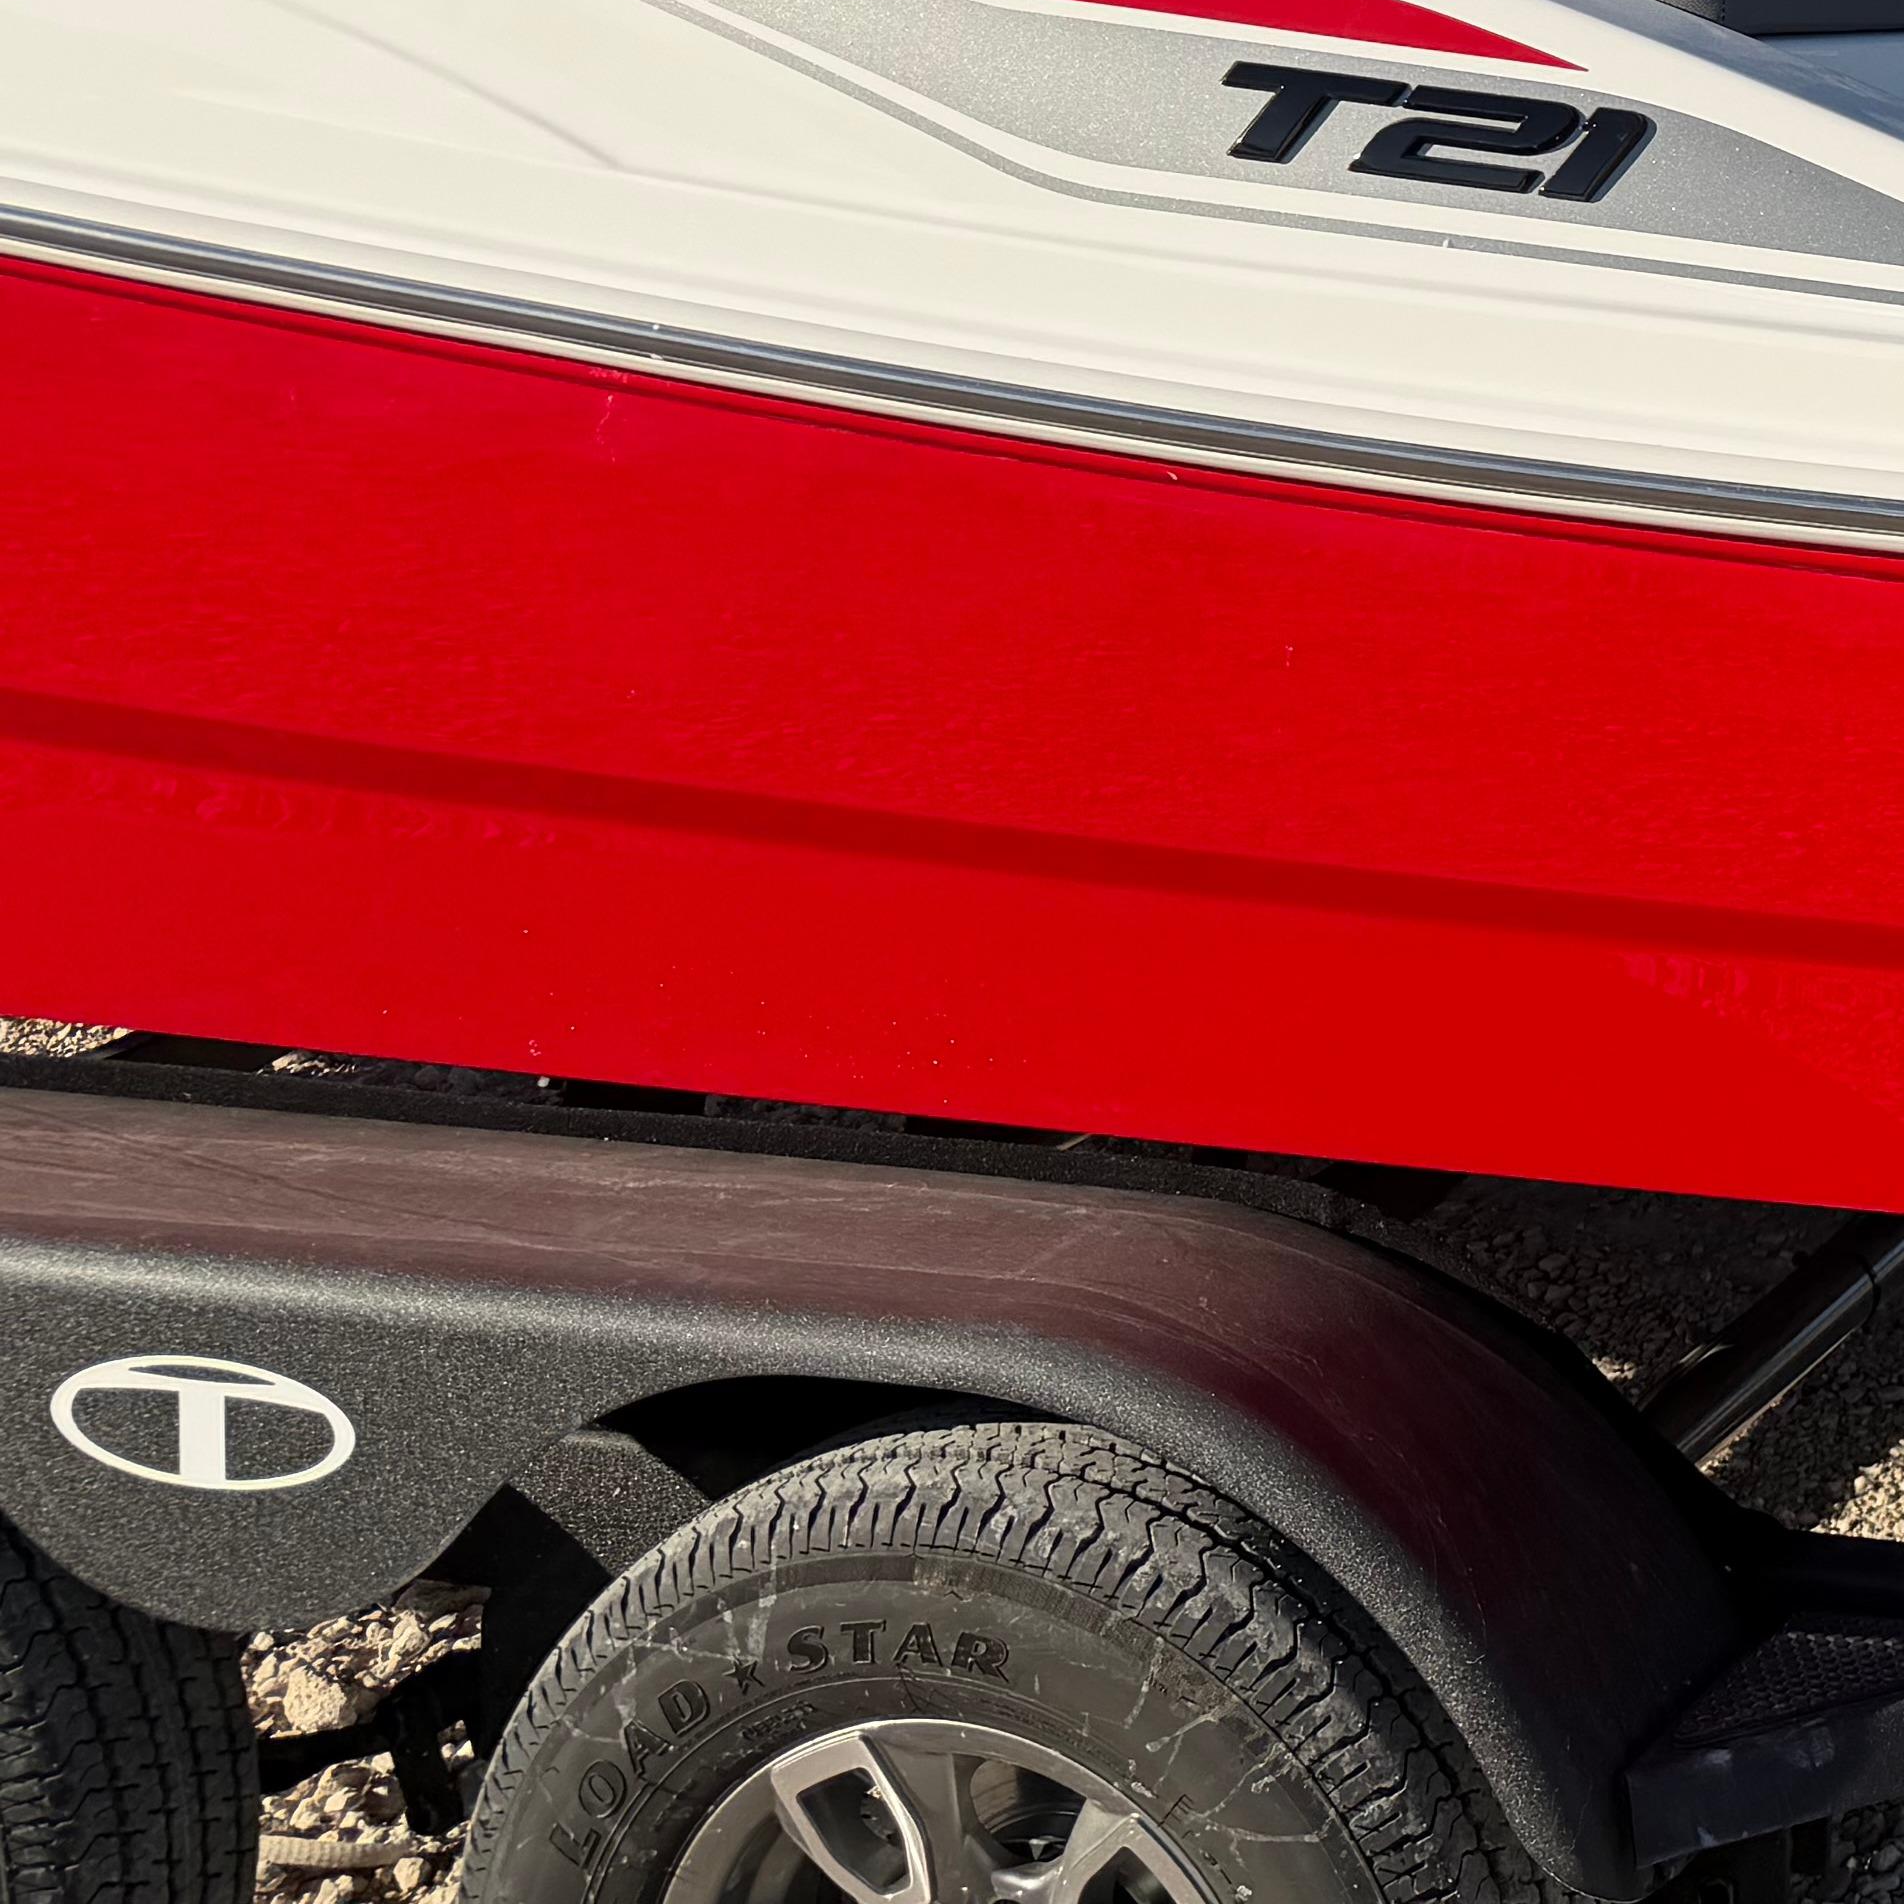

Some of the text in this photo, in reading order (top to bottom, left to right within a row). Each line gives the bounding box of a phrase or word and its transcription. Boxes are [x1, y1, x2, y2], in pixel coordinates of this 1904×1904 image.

[1220, 60, 1657, 204] T21
[549, 1618, 1010, 1873] LOAD STAR
